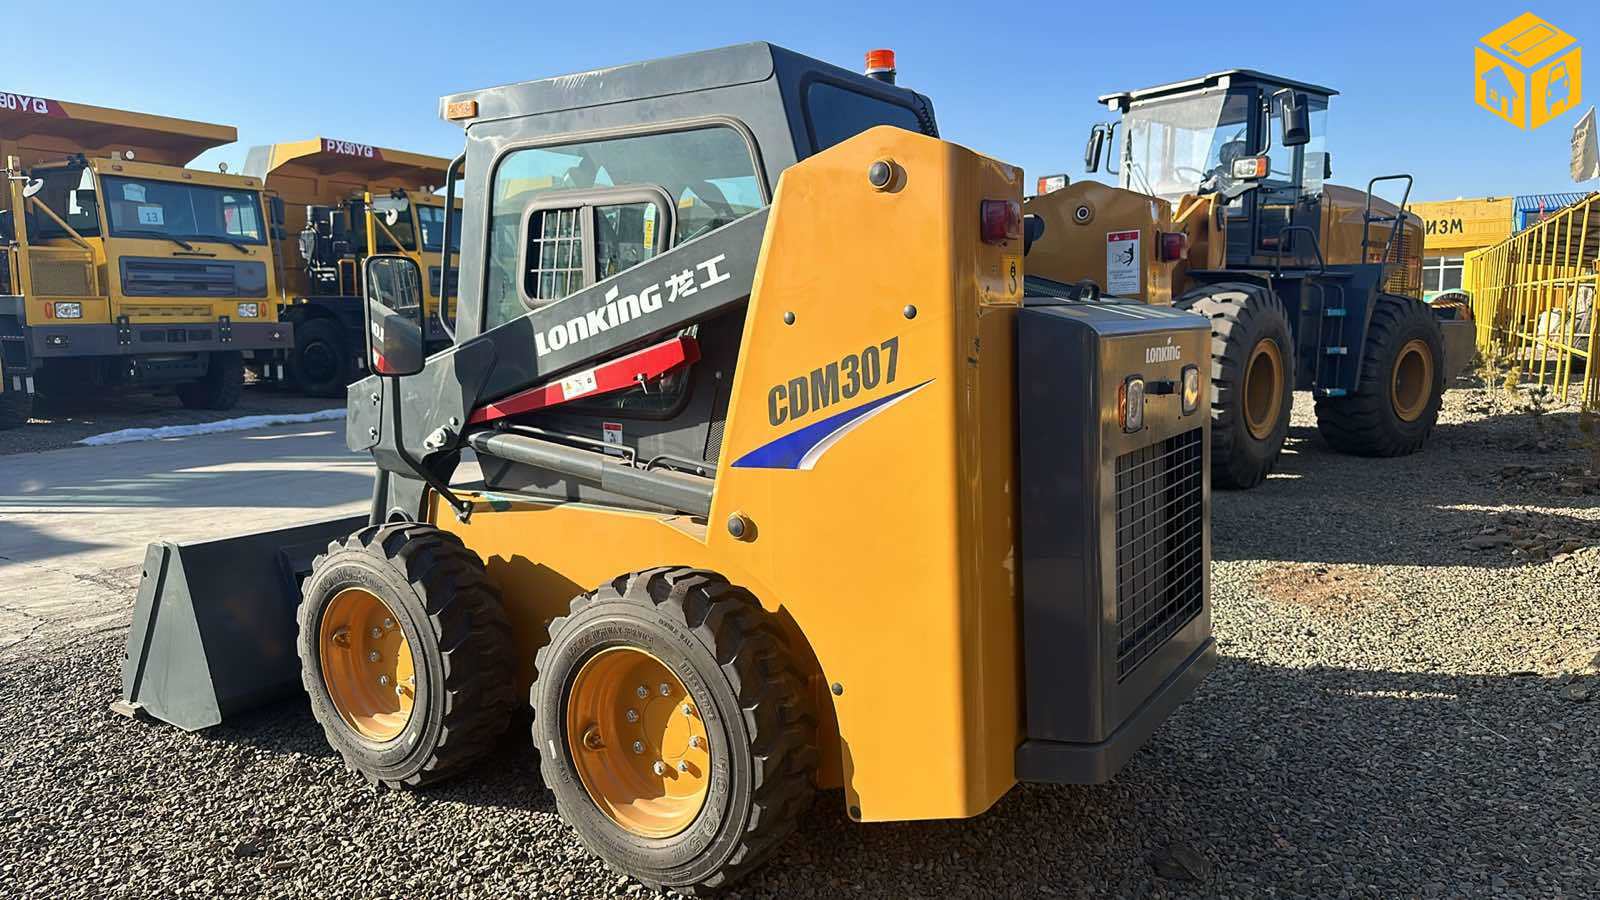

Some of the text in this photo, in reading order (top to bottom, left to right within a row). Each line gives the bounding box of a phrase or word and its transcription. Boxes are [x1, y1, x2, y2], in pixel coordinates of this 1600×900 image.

[0, 93, 48, 113] 90YQ
[327, 140, 373, 157] PX90YQ
[144, 212, 158, 222] 13
[1425, 219, 1463, 235] ИЗМ
[534, 253, 731, 357] LONKING 龙工
[1145, 337, 1181, 364] LONKING
[768, 336, 898, 426] CDM307
